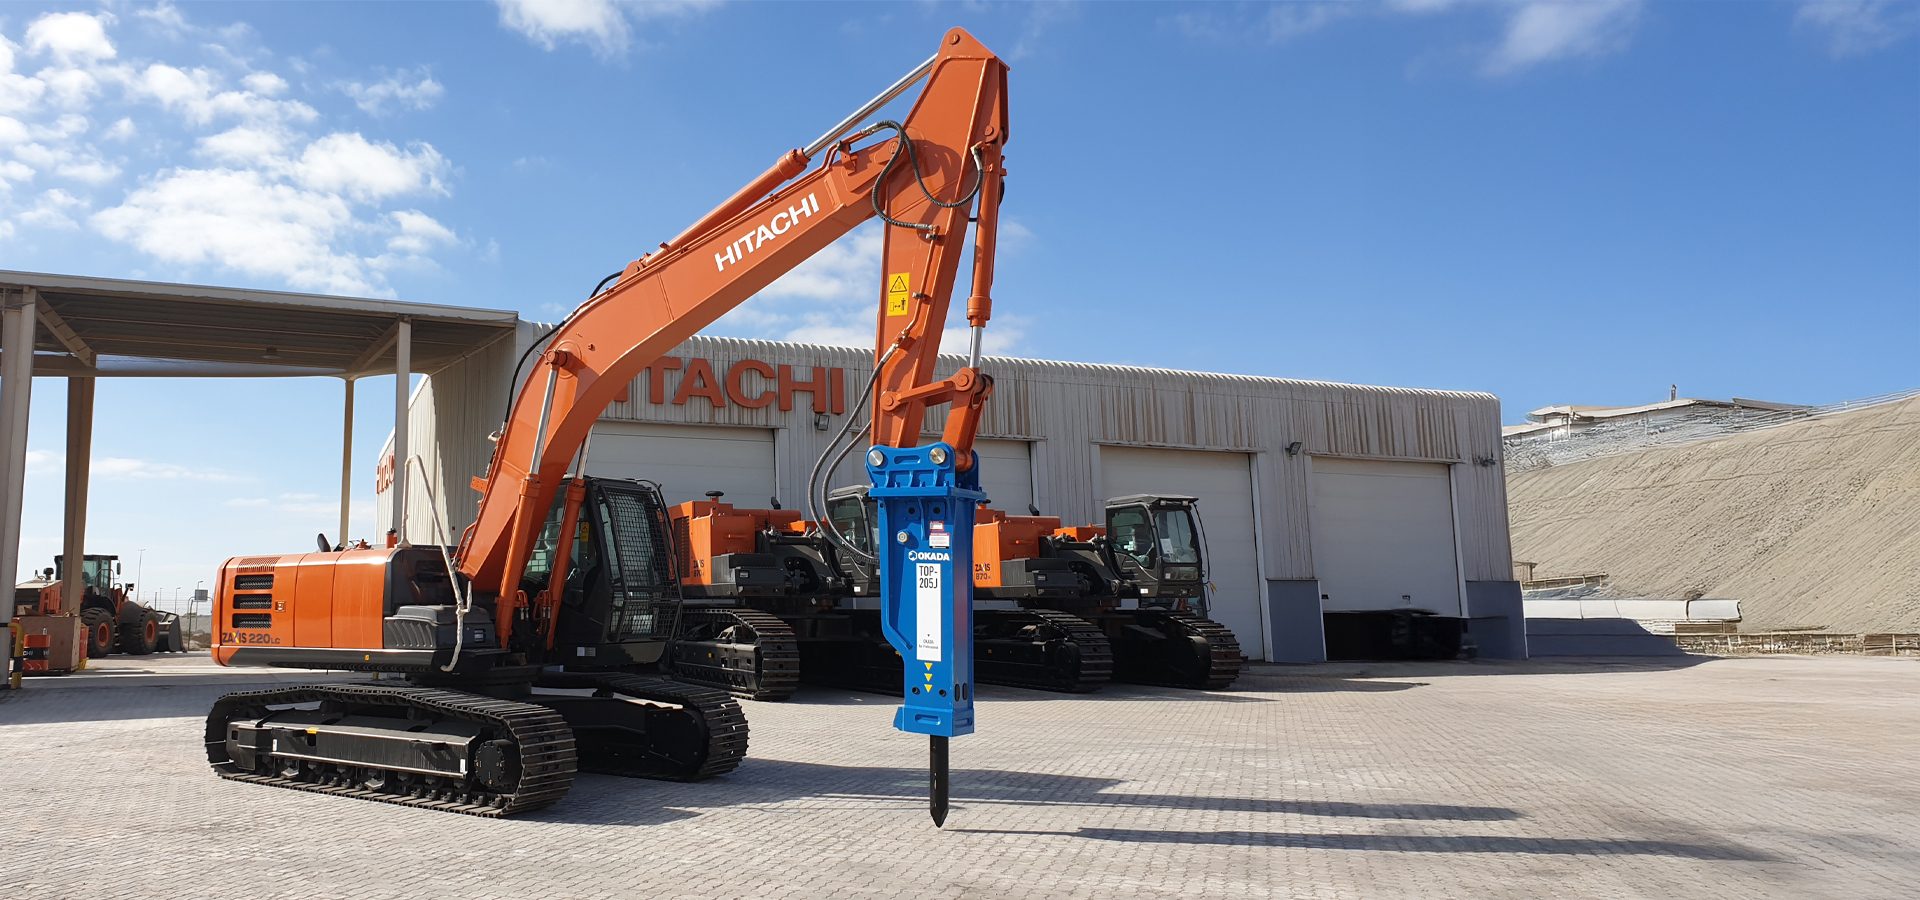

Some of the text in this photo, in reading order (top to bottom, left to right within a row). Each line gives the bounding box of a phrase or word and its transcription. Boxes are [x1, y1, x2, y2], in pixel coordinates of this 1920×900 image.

[714, 192, 820, 272] HITACHI
[614, 355, 844, 414] TACHI
[917, 551, 950, 561] OKADA
[919, 565, 938, 577] TOP-
[919, 577, 938, 589] 205J
[222, 630, 247, 644] ZAXIS
